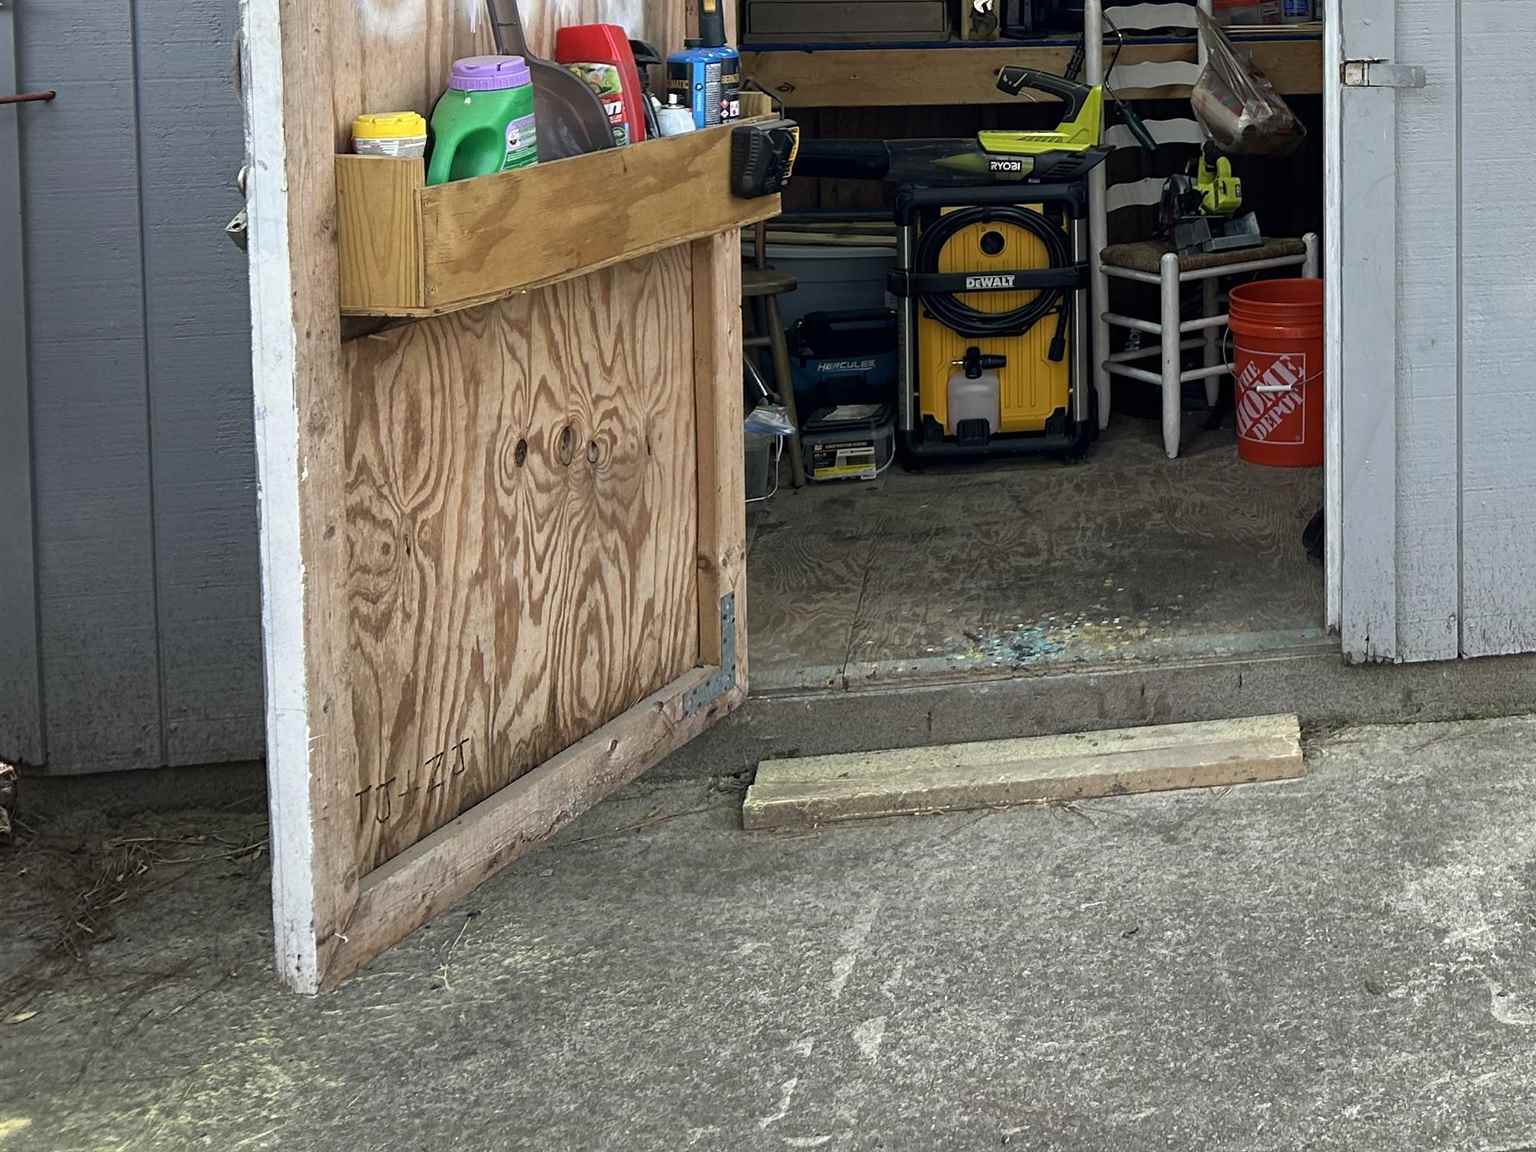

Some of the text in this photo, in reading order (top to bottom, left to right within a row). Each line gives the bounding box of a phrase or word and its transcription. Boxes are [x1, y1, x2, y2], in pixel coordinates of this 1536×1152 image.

[990, 161, 1021, 171] RYOBI
[1236, 354, 1304, 438] HOME
[1240, 360, 1259, 393] THE
[1252, 389, 1303, 440] DEPOT
